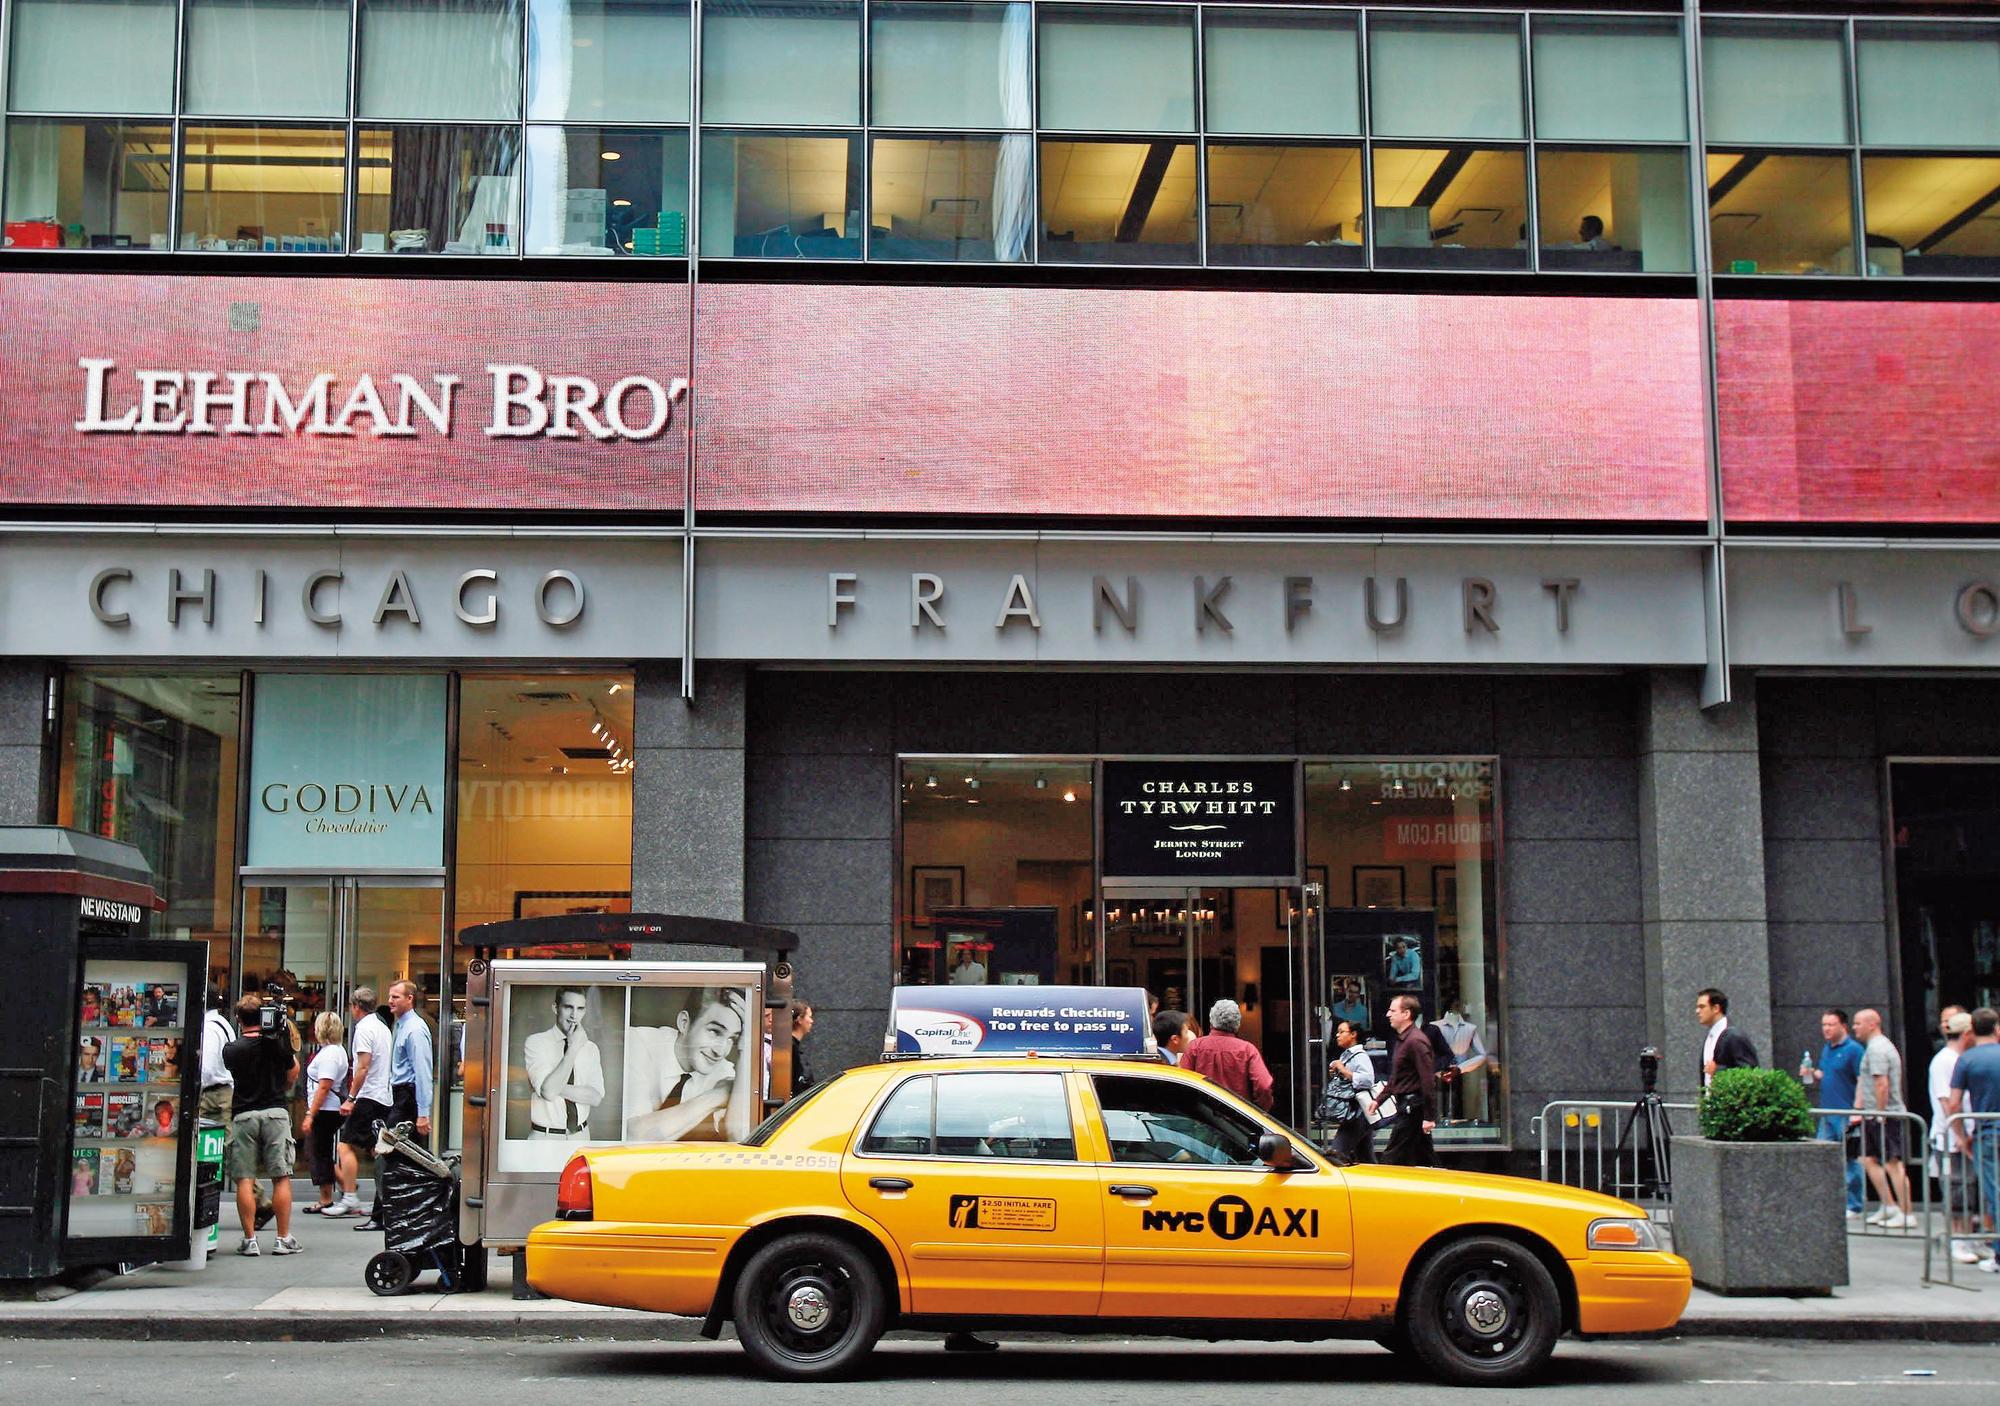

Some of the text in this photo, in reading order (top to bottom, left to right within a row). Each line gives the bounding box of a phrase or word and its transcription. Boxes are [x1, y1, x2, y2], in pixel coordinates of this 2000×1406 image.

[75, 357, 688, 441] LEHMAN BRO
[88, 567, 586, 626] CHICAGO
[827, 572, 1581, 634] FRANKFURT
[1142, 781, 1254, 794] CHARLES
[261, 783, 434, 815] GODIVA
[1120, 801, 1276, 815] TYRWHITT
[304, 817, 388, 834] Chocolatier
[1153, 840, 1244, 849] JERMYN STREET
[1175, 850, 1222, 859] LONDON
[80, 896, 141, 924] NEWSSTAND
[628, 924, 662, 934] verizon
[992, 1007, 1130, 1020] Rewards Checking.
[989, 1020, 1134, 1034] Too free to pass up.
[981, 1200, 1002, 1208] $2.50
[1003, 1201, 1031, 1209] INITIAL
[1142, 1198, 1319, 1239] NYC TAXI
